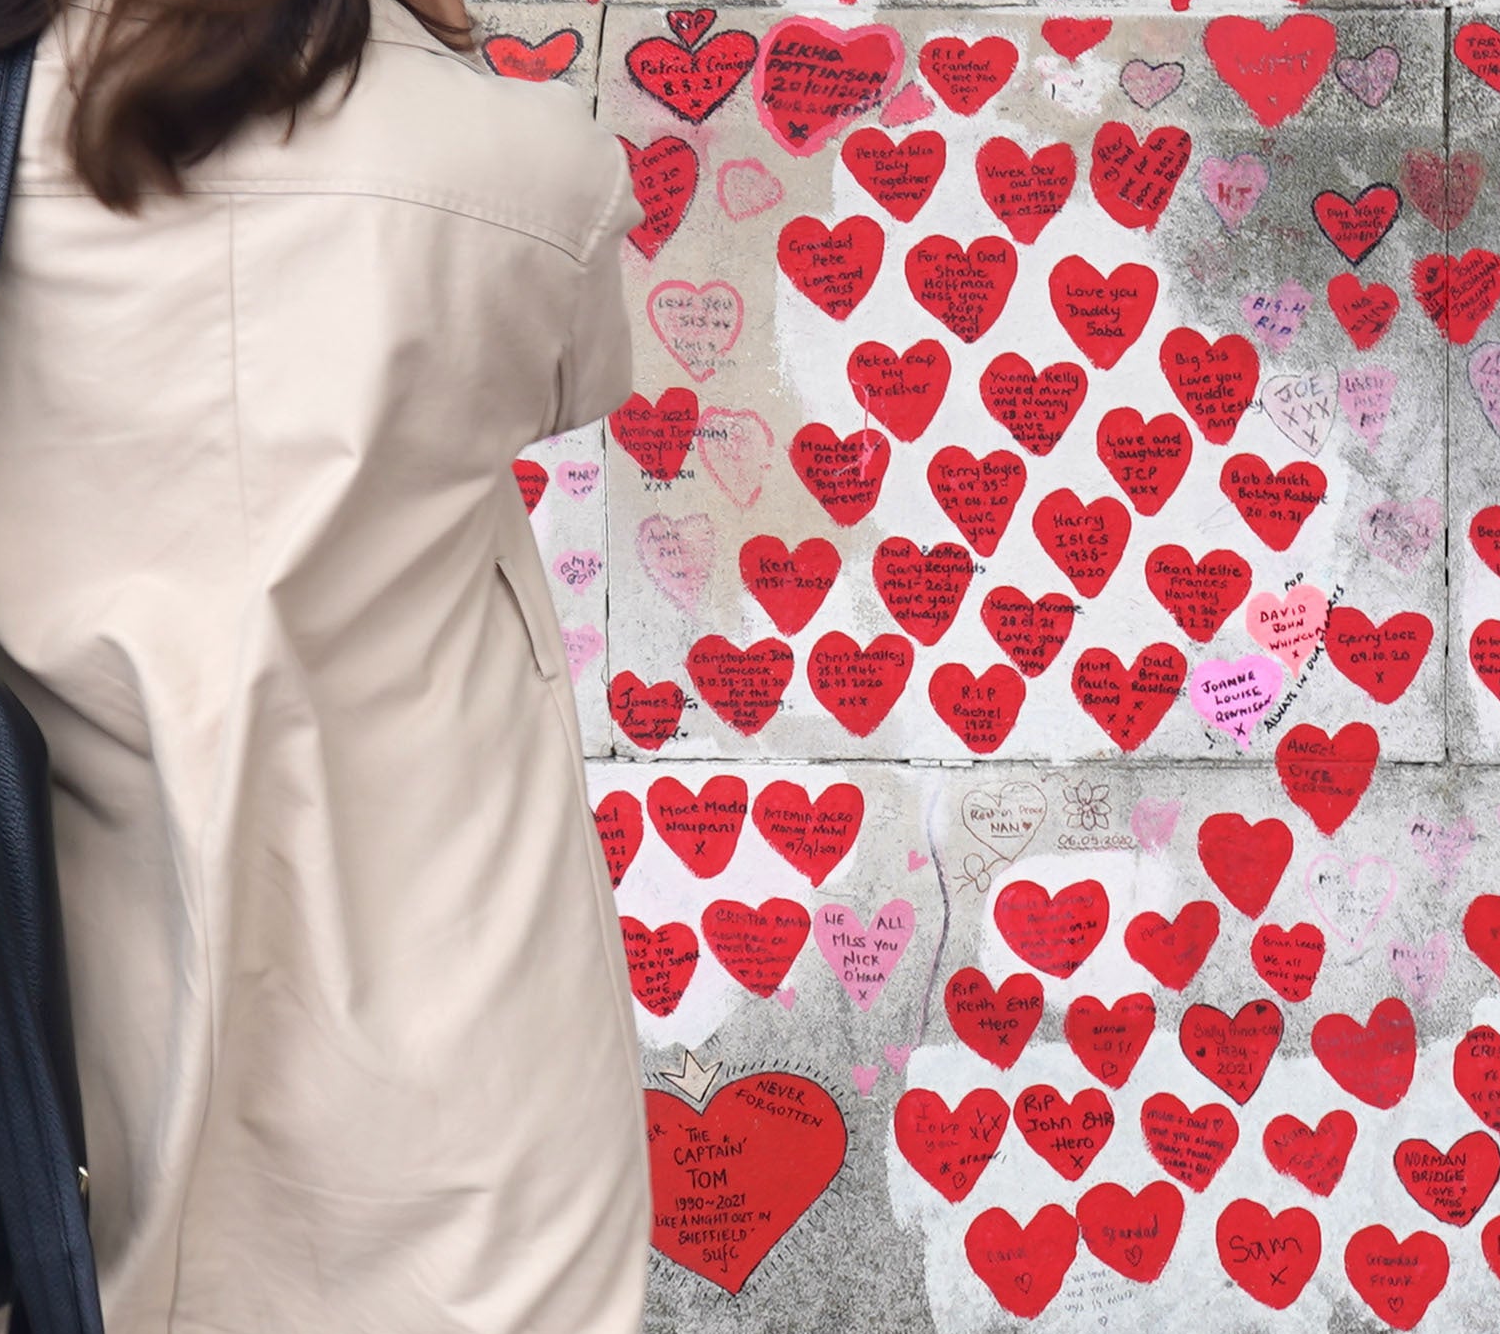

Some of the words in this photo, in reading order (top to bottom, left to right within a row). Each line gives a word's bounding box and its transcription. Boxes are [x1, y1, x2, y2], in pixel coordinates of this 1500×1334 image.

[1066, 282, 1104, 297] Love
[1109, 287, 1137, 301] you
[1069, 304, 1120, 320] Daddy
[1273, 376, 1321, 403] JOE
[1106, 433, 1139, 447] Love
[1155, 433, 1181, 445] and
[1231, 471, 1261, 485] Bob
[1265, 475, 1310, 487] Smith
[1053, 514, 1104, 530] Harry
[1259, 604, 1306, 623] DAVID
[1272, 618, 1304, 633] JOHN
[1384, 630, 1415, 642] Lock
[824, 912, 846, 926] WE
[877, 917, 902, 930] ALL
[832, 934, 866, 947] MISS
[873, 938, 898, 952] YOU
[843, 950, 880, 966] NICK
[757, 1079, 805, 1106] NEVER
[736, 1089, 823, 1127] FORGOTTEN
[1403, 1154, 1465, 1167] NORMAN
[685, 1168, 728, 1188] TOM
[1411, 1170, 1464, 1182] BRIDGE
[691, 1212, 727, 1225] NIGHT
[727, 1211, 751, 1223] OUT
[757, 1210, 771, 1222] IN
[1229, 1234, 1302, 1263] Sam
